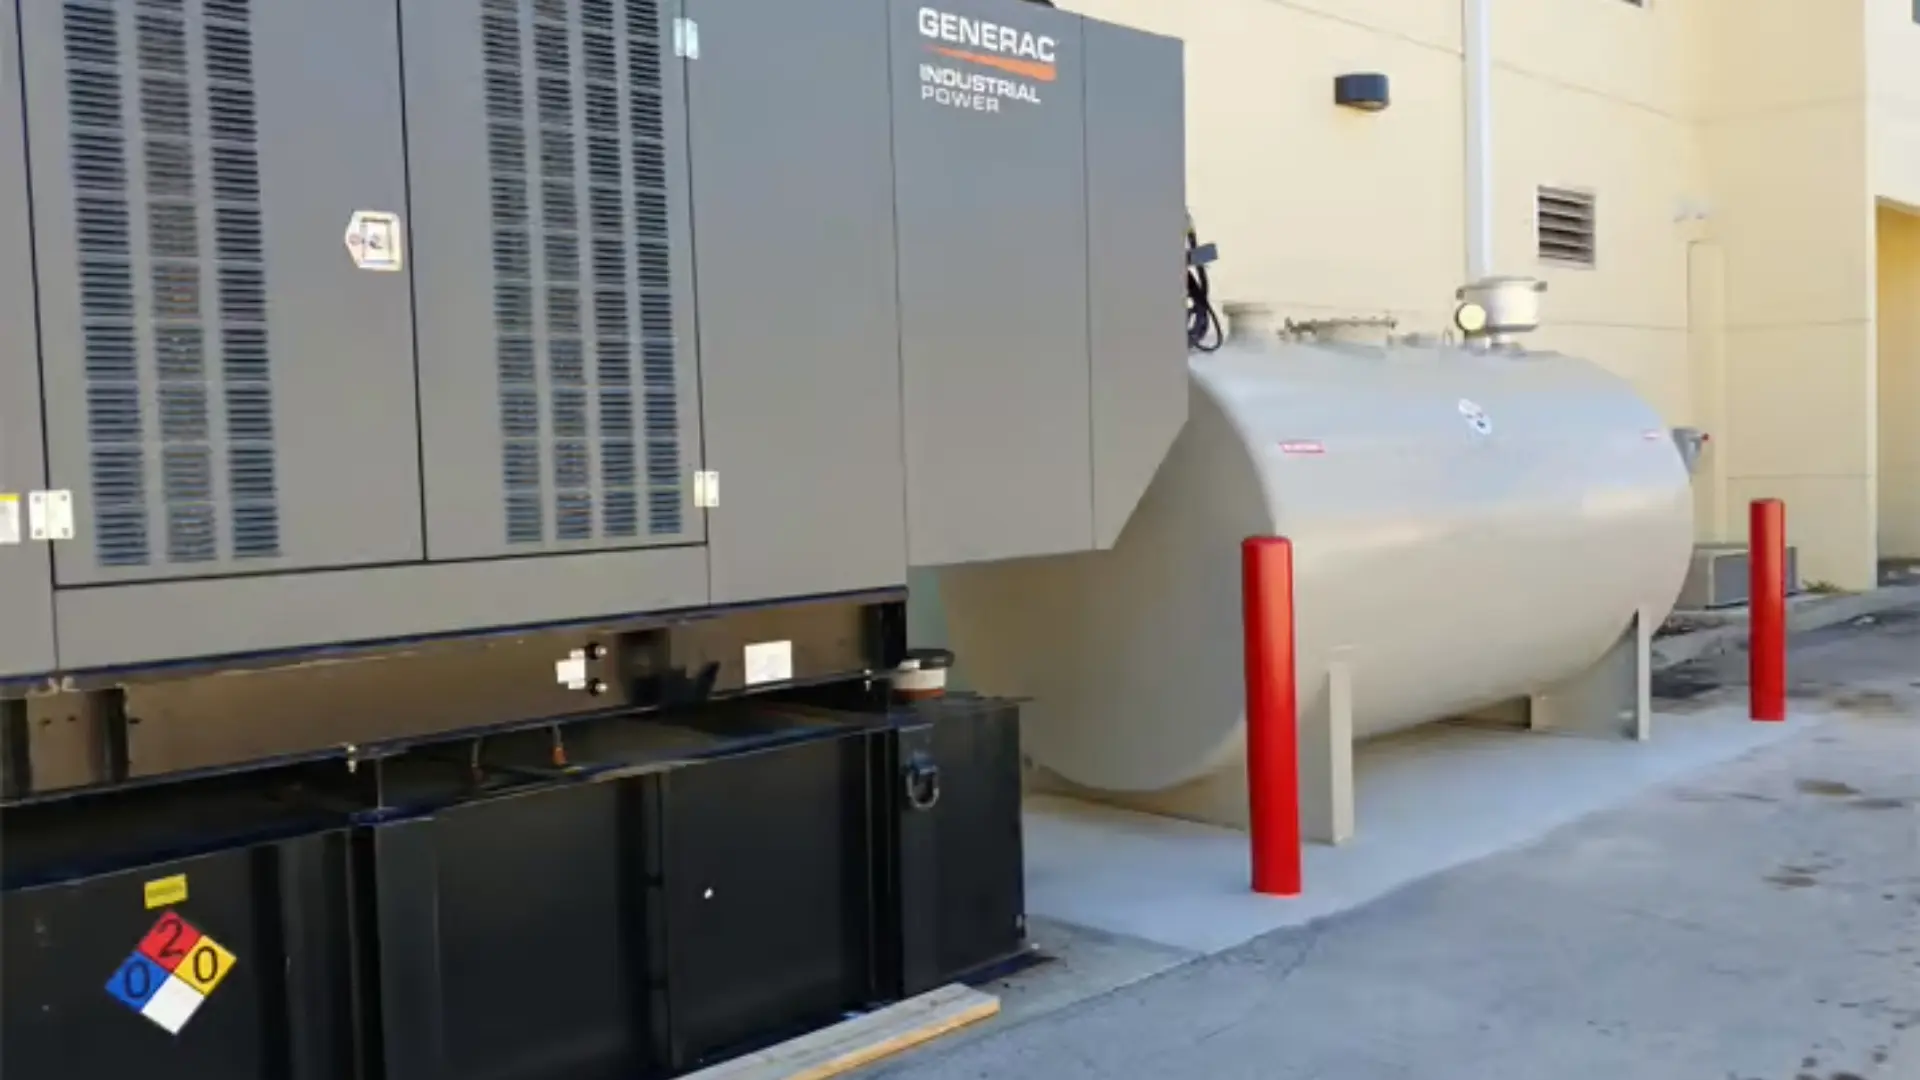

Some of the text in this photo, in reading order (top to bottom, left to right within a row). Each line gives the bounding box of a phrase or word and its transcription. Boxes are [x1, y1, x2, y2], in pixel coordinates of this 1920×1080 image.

[919, 7, 1056, 62] GENERAC
[919, 63, 1041, 104] INDUSTRIAL
[921, 84, 999, 112] POWER
[156, 918, 184, 957] 2
[124, 960, 149, 998] 0
[193, 945, 218, 983] 0
